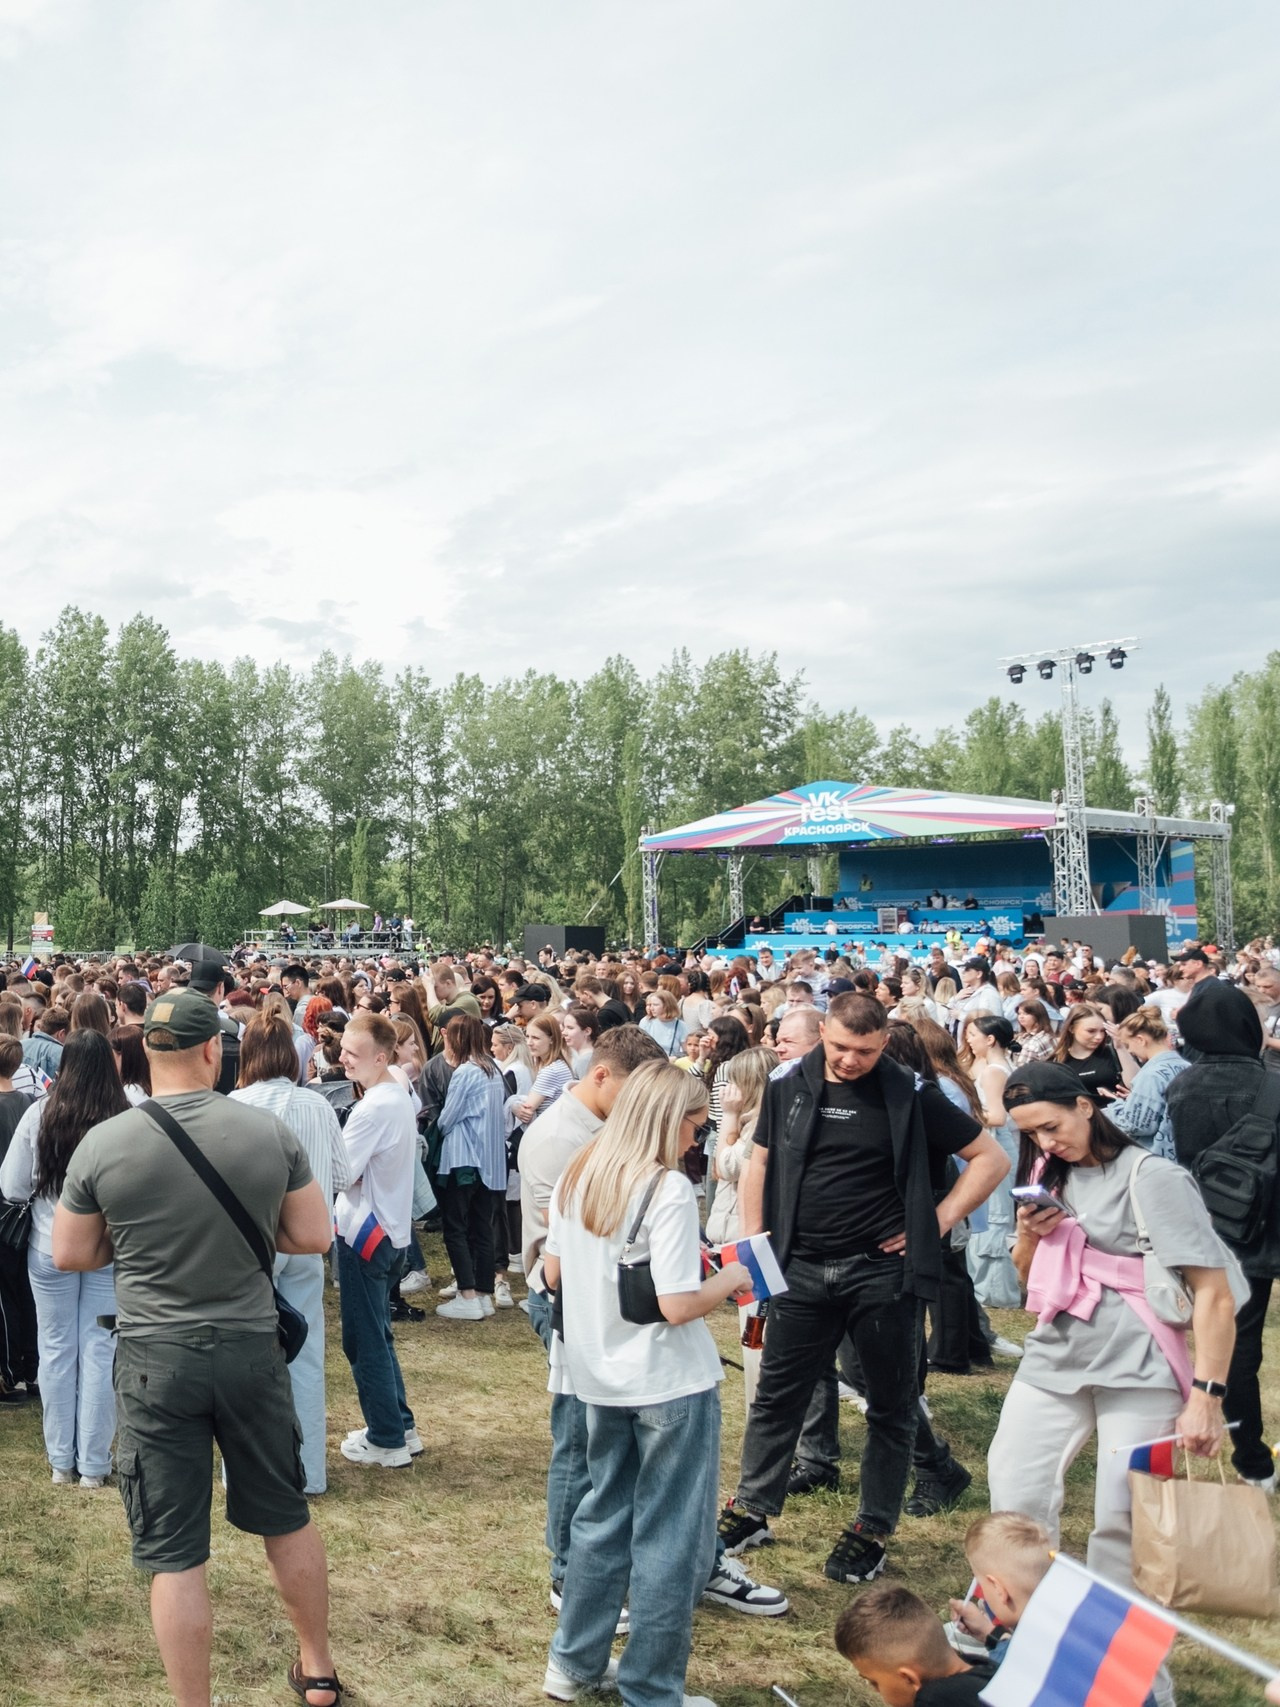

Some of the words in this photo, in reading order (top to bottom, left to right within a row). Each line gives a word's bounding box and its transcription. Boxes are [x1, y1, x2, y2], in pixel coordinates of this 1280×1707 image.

[808, 790, 841, 807] VK
[800, 800, 854, 822] fest
[784, 822, 871, 837] КРАСНОЯРСК
[992, 916, 1010, 925] VK
